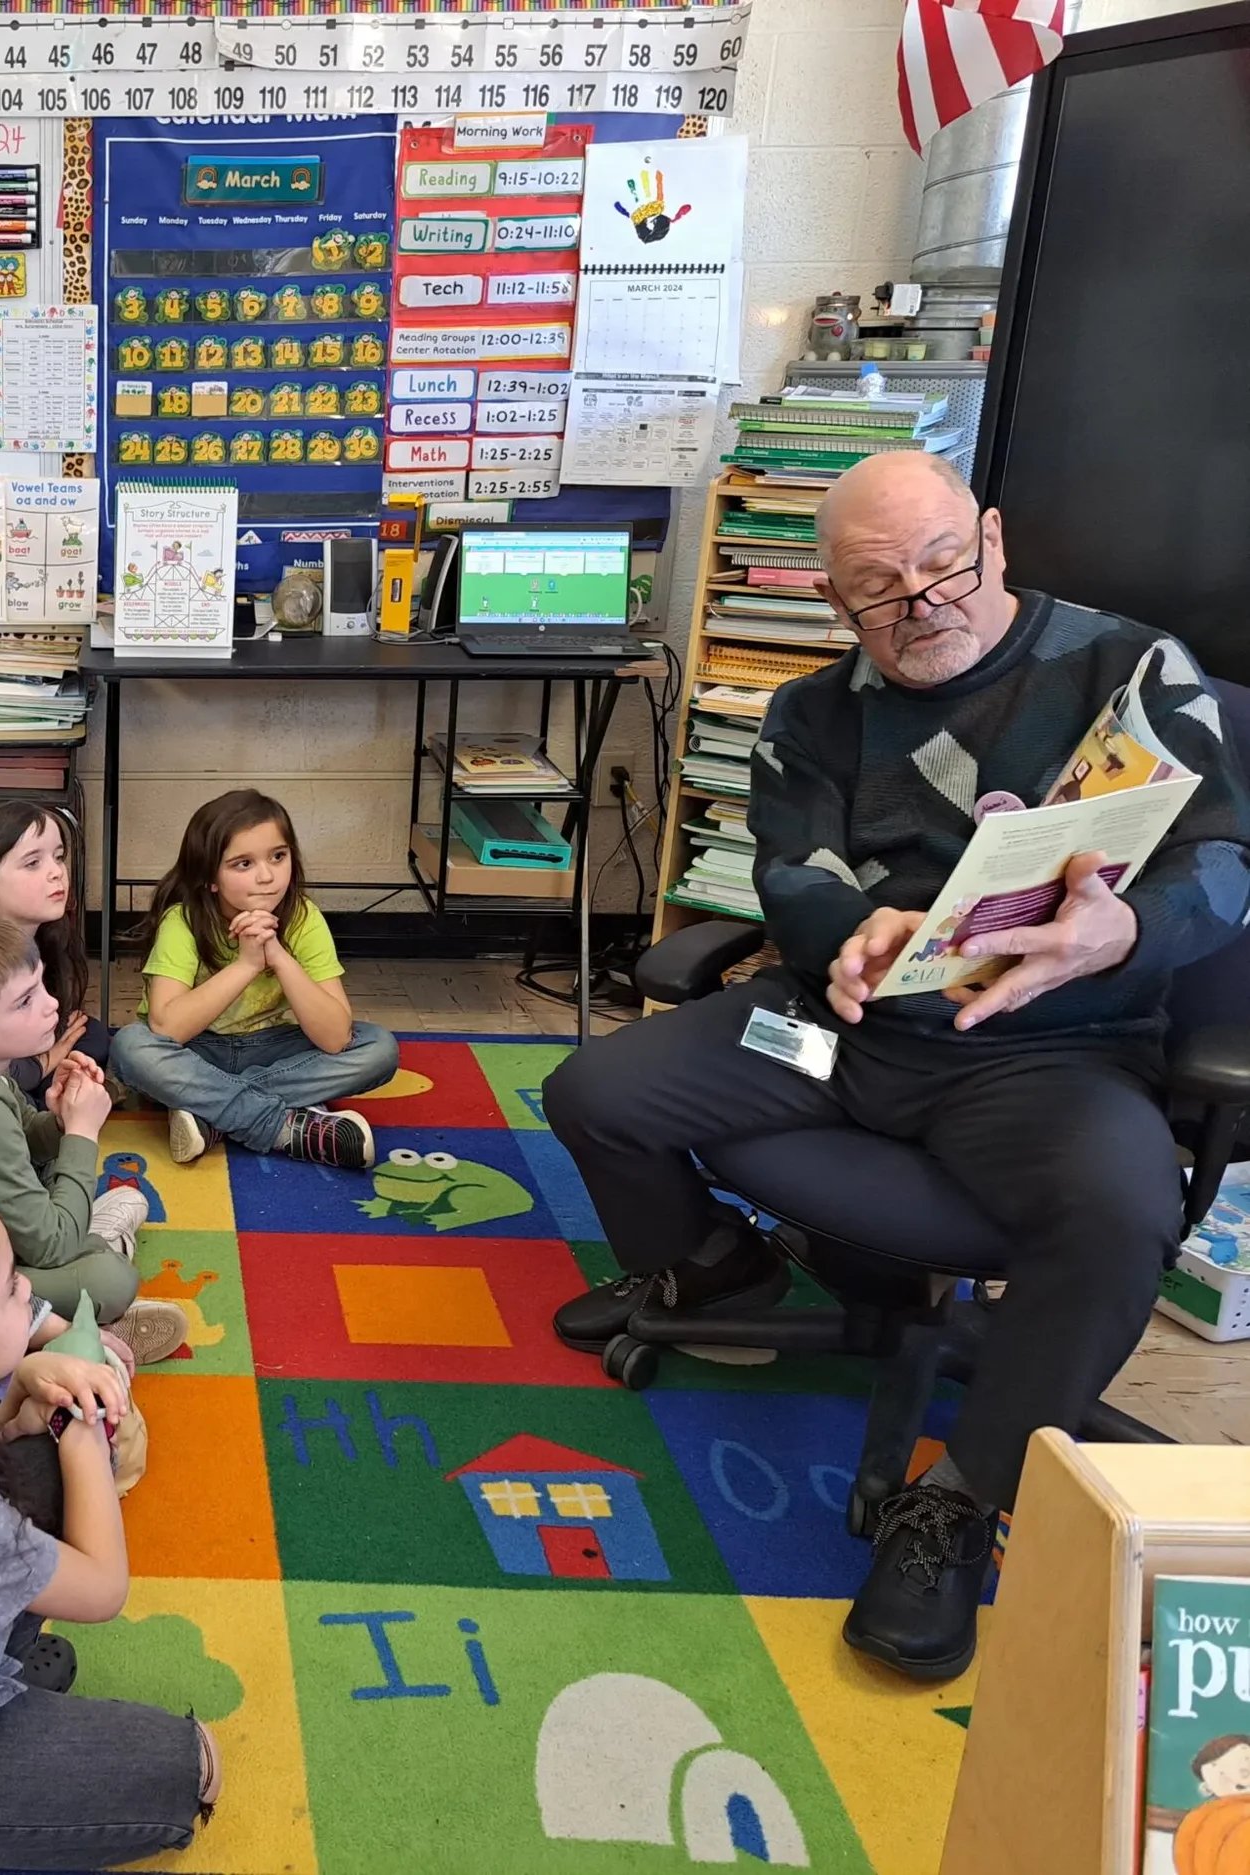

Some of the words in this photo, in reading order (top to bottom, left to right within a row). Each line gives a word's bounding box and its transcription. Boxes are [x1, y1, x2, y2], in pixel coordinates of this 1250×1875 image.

[48, 45, 70, 67] 45
[180, 42, 202, 64] 48
[319, 44, 338, 67] 51
[495, 45, 517, 67] 55
[673, 43, 697, 67] 59
[168, 87, 197, 109] 108
[347, 86, 374, 107] 112
[479, 85, 506, 107] 115
[613, 84, 638, 107] 118
[457, 126, 508, 140] Morning
[512, 125, 543, 138] Work
[225, 171, 281, 189] March
[419, 169, 478, 191] Reading
[498, 172, 579, 187] 9:15-10:22
[121, 216, 148, 226] Sunday
[158, 216, 188, 227] Monday
[198, 217, 228, 227] Tuesday
[232, 216, 272, 225] Wednesday
[275, 215, 309, 225] Thursday
[318, 213, 343, 223] Friday
[353, 211, 387, 220] Saturday
[413, 225, 473, 249] Writing
[423, 281, 464, 296] Tech
[627, 285, 661, 293] MARCH
[663, 284, 684, 292] 2024
[399, 333, 439, 344] Reading
[441, 333, 476, 343] Groups
[396, 346, 431, 356] Center
[433, 345, 477, 355] Rotation
[409, 374, 458, 394] Lunch
[487, 380, 568, 395] 12:39-1:02
[405, 408, 457, 426] Recess
[486, 410, 558, 424] 1:02-1:25
[121, 440, 150, 461] 24
[271, 439, 302, 460] 28
[309, 440, 340, 460] 29
[411, 446, 447, 463] Math
[479, 448, 552, 462] 1:25-2:25
[12, 482, 44, 493] Vowel
[48, 482, 83, 493] Teams
[388, 478, 455, 489] Interventions
[475, 480, 552, 495] 2:25-2:55
[34, 495, 57, 506] and
[140, 508, 165, 519] Story
[167, 508, 211, 518] Structure
[8, 546, 31, 555] boat
[60, 548, 83, 557] goat
[7, 599, 29, 607] blow
[58, 600, 82, 610] grow
[281, 1389, 442, 1469] Hh
[1177, 1607, 1242, 1636] how
[318, 1609, 502, 1709] Ii
